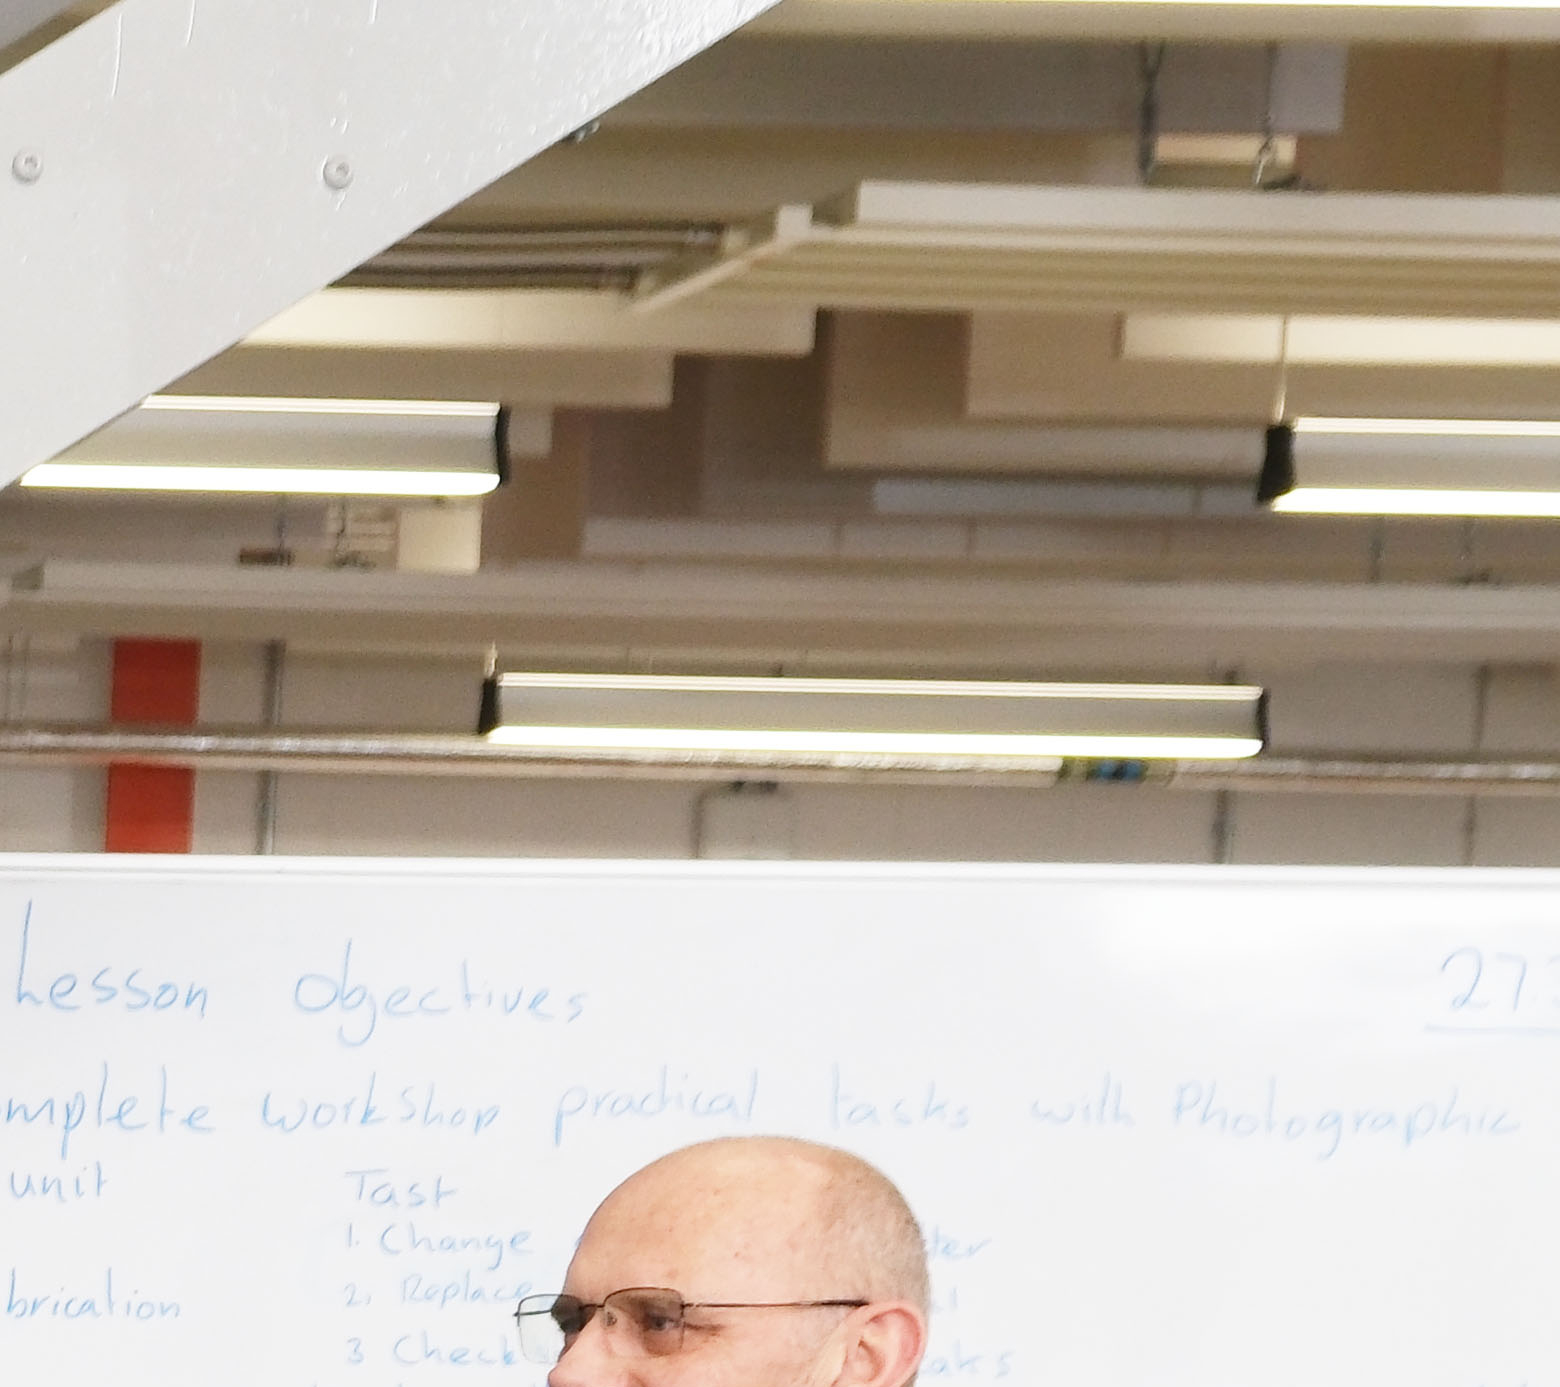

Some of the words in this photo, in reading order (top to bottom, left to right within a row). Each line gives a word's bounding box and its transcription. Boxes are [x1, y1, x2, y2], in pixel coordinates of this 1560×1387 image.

[17, 899, 209, 1016] Lesson
[554, 1064, 758, 1147] practical
[830, 1063, 971, 1131] tasks
[9, 1167, 109, 1200] unit
[378, 1220, 532, 1273] Change
